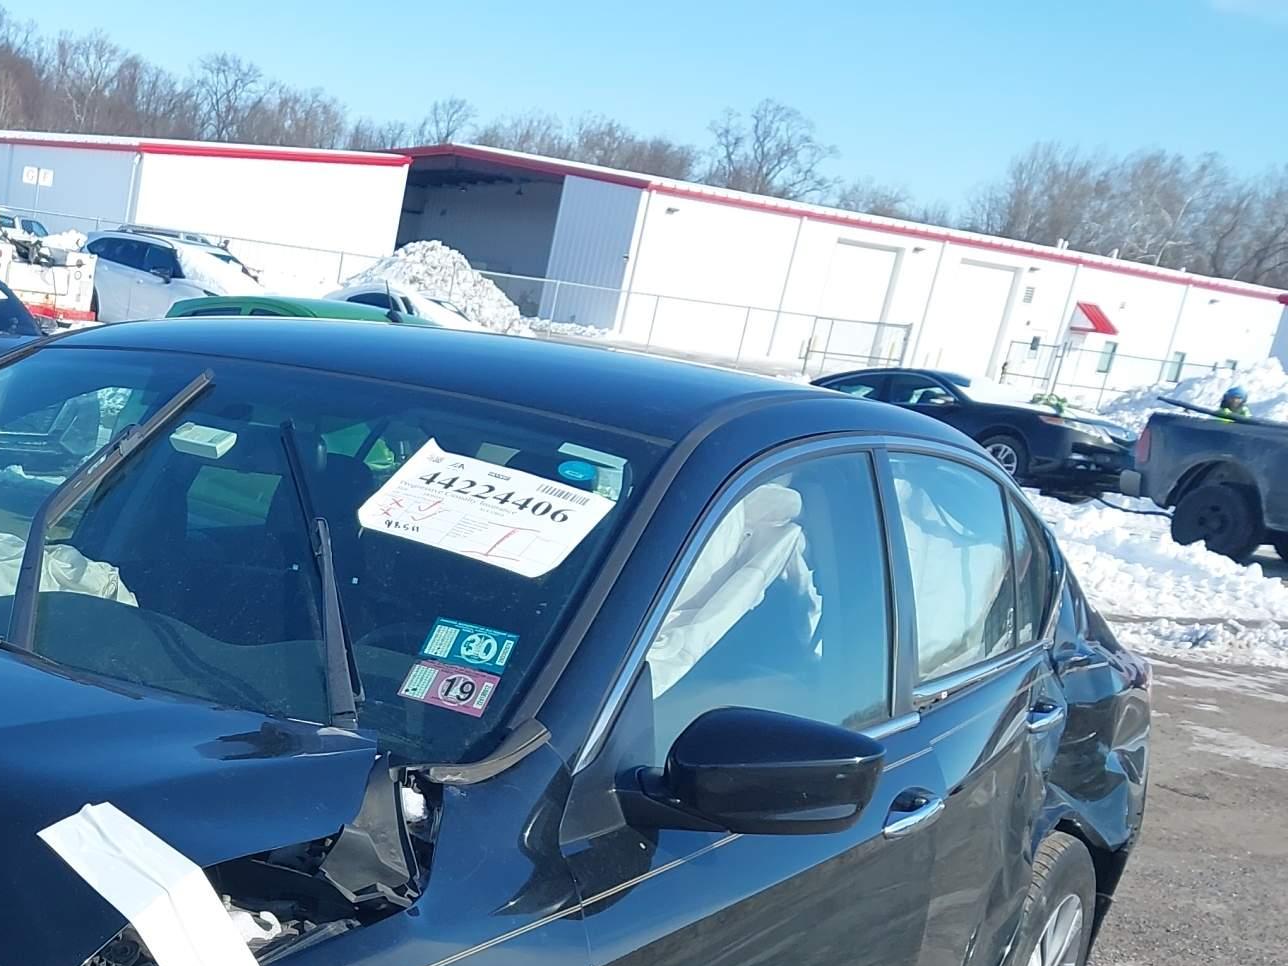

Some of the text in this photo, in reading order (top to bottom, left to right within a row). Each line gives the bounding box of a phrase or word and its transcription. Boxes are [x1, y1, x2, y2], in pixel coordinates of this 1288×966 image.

[419, 471, 577, 523] 44224406
[464, 634, 495, 660] 30
[443, 677, 476, 702] 19
